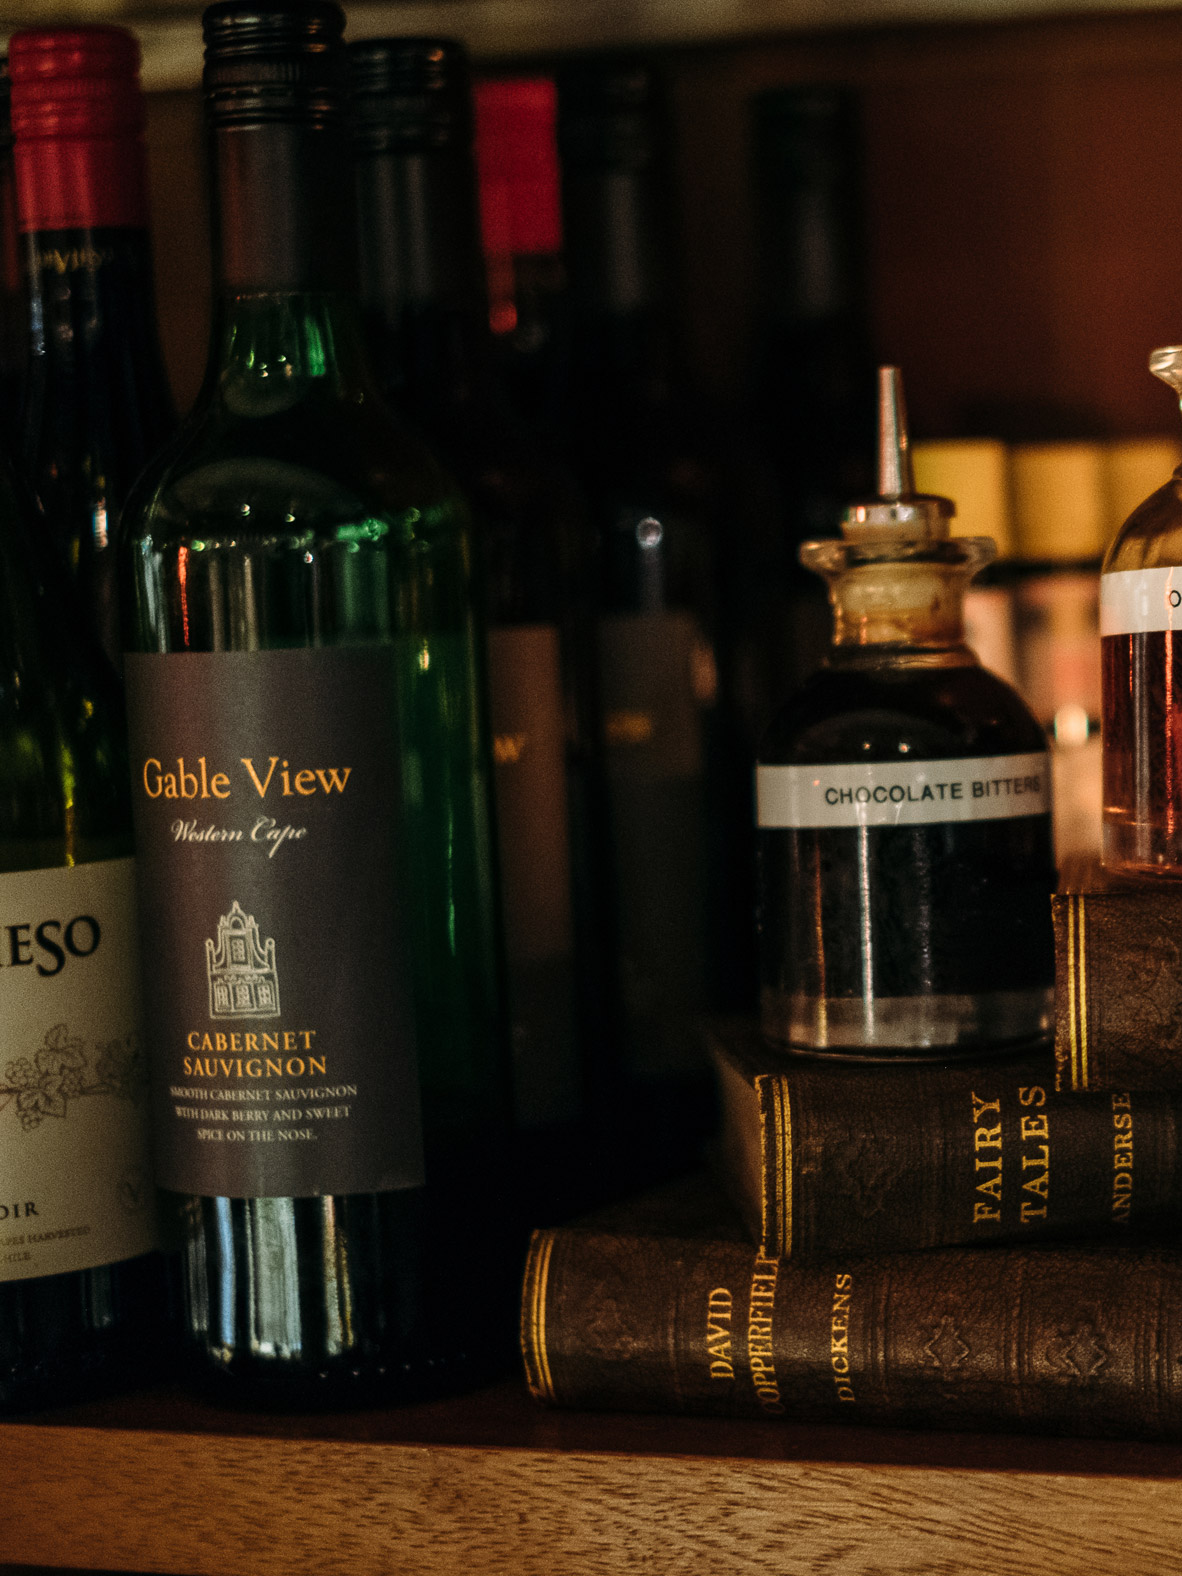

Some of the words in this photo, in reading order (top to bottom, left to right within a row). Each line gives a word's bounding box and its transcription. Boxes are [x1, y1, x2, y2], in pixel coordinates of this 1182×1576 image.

[143, 756, 231, 800] Gable
[241, 756, 352, 799] View
[824, 782, 963, 805] CHOCOLATE
[971, 774, 1041, 798] BITTERS
[171, 818, 243, 843] Western
[250, 815, 309, 859] Cape
[0, 915, 101, 977] ESO
[187, 1029, 317, 1052] CABERNET
[183, 1055, 327, 1078] SAUVIGNON
[200, 1109, 230, 1122] DARK
[232, 1109, 270, 1123] BERRY
[273, 1109, 303, 1122] AND
[305, 1104, 352, 1120] SWEET
[210, 1088, 271, 1102] CABERNET
[275, 1084, 359, 1101] SAUVIGNON
[196, 1128, 225, 1142] SPICE
[226, 1129, 246, 1142] ON
[248, 1129, 275, 1143] THE
[971, 1090, 1002, 1224] FAIRY
[1018, 1085, 1049, 1224] TALES
[1111, 1092, 1133, 1224] ANDERSE
[706, 1287, 735, 1381] DAVID
[831, 1273, 856, 1403] DICKENS
